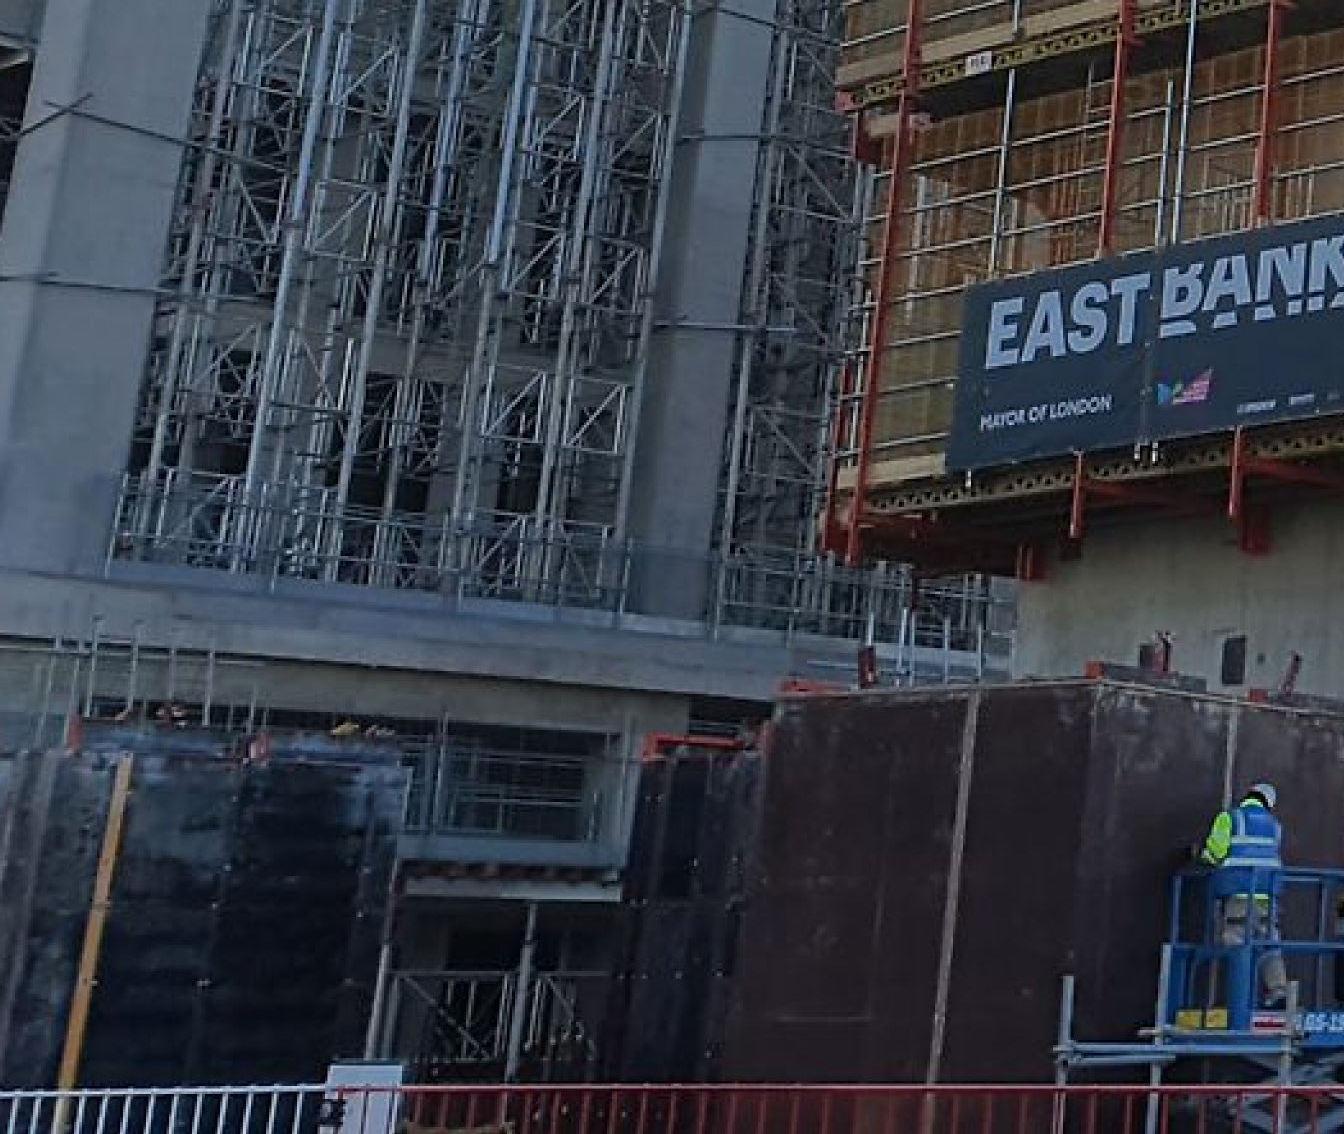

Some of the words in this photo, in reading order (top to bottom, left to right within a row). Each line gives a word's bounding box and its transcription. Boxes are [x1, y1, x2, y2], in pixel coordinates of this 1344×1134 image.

[985, 273, 1151, 370] EAST
[1029, 404, 1048, 423] OF
[1050, 394, 1112, 419] LONDON
